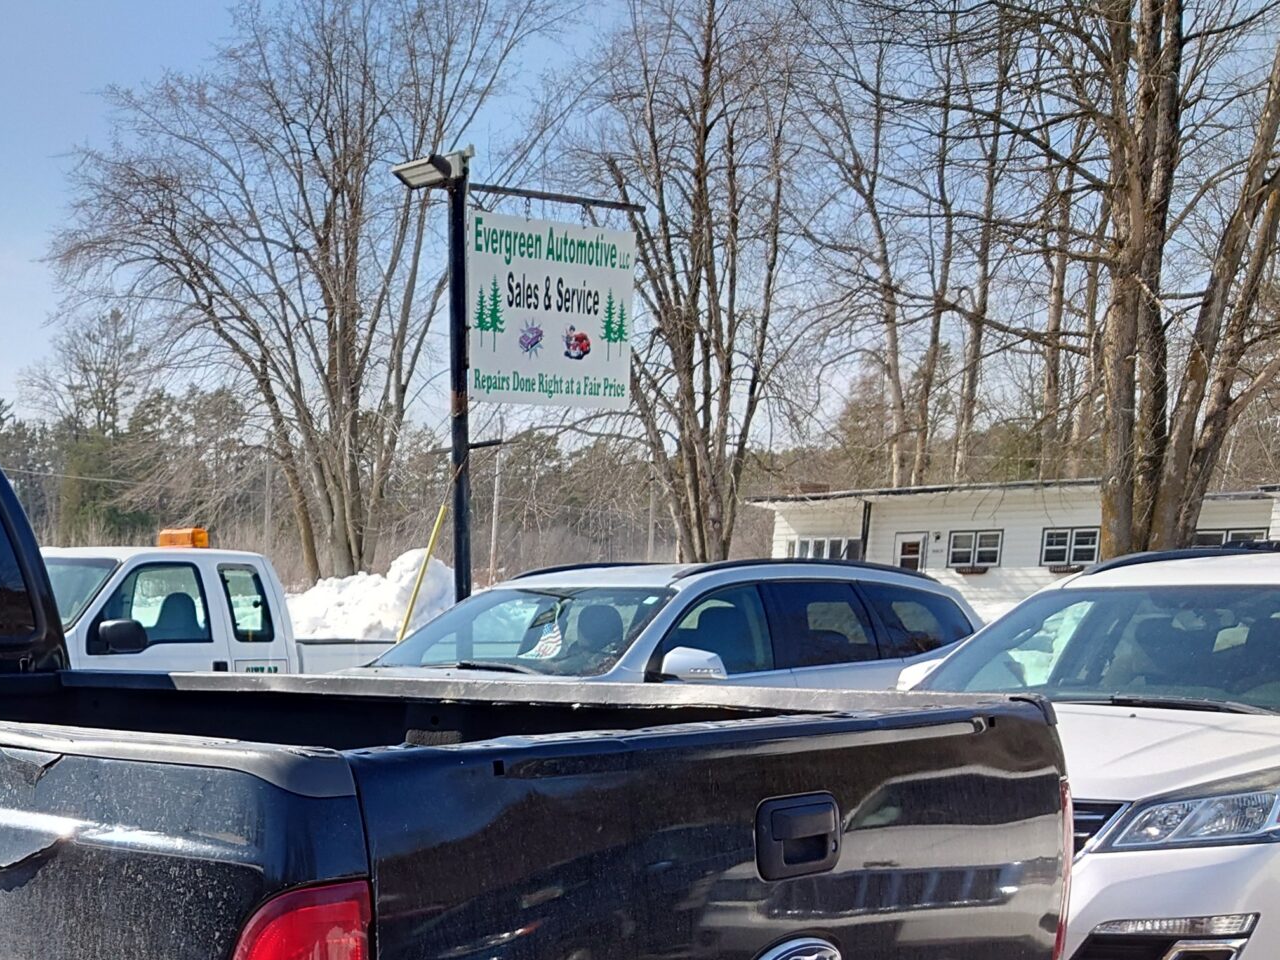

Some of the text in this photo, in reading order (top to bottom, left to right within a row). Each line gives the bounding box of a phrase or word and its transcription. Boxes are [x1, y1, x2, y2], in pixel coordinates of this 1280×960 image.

[475, 217, 631, 270] Evergreen Automotive LLC
[507, 271, 600, 315] Sales & Service
[474, 368, 626, 399] Repairs Done Right at a Fair Price
